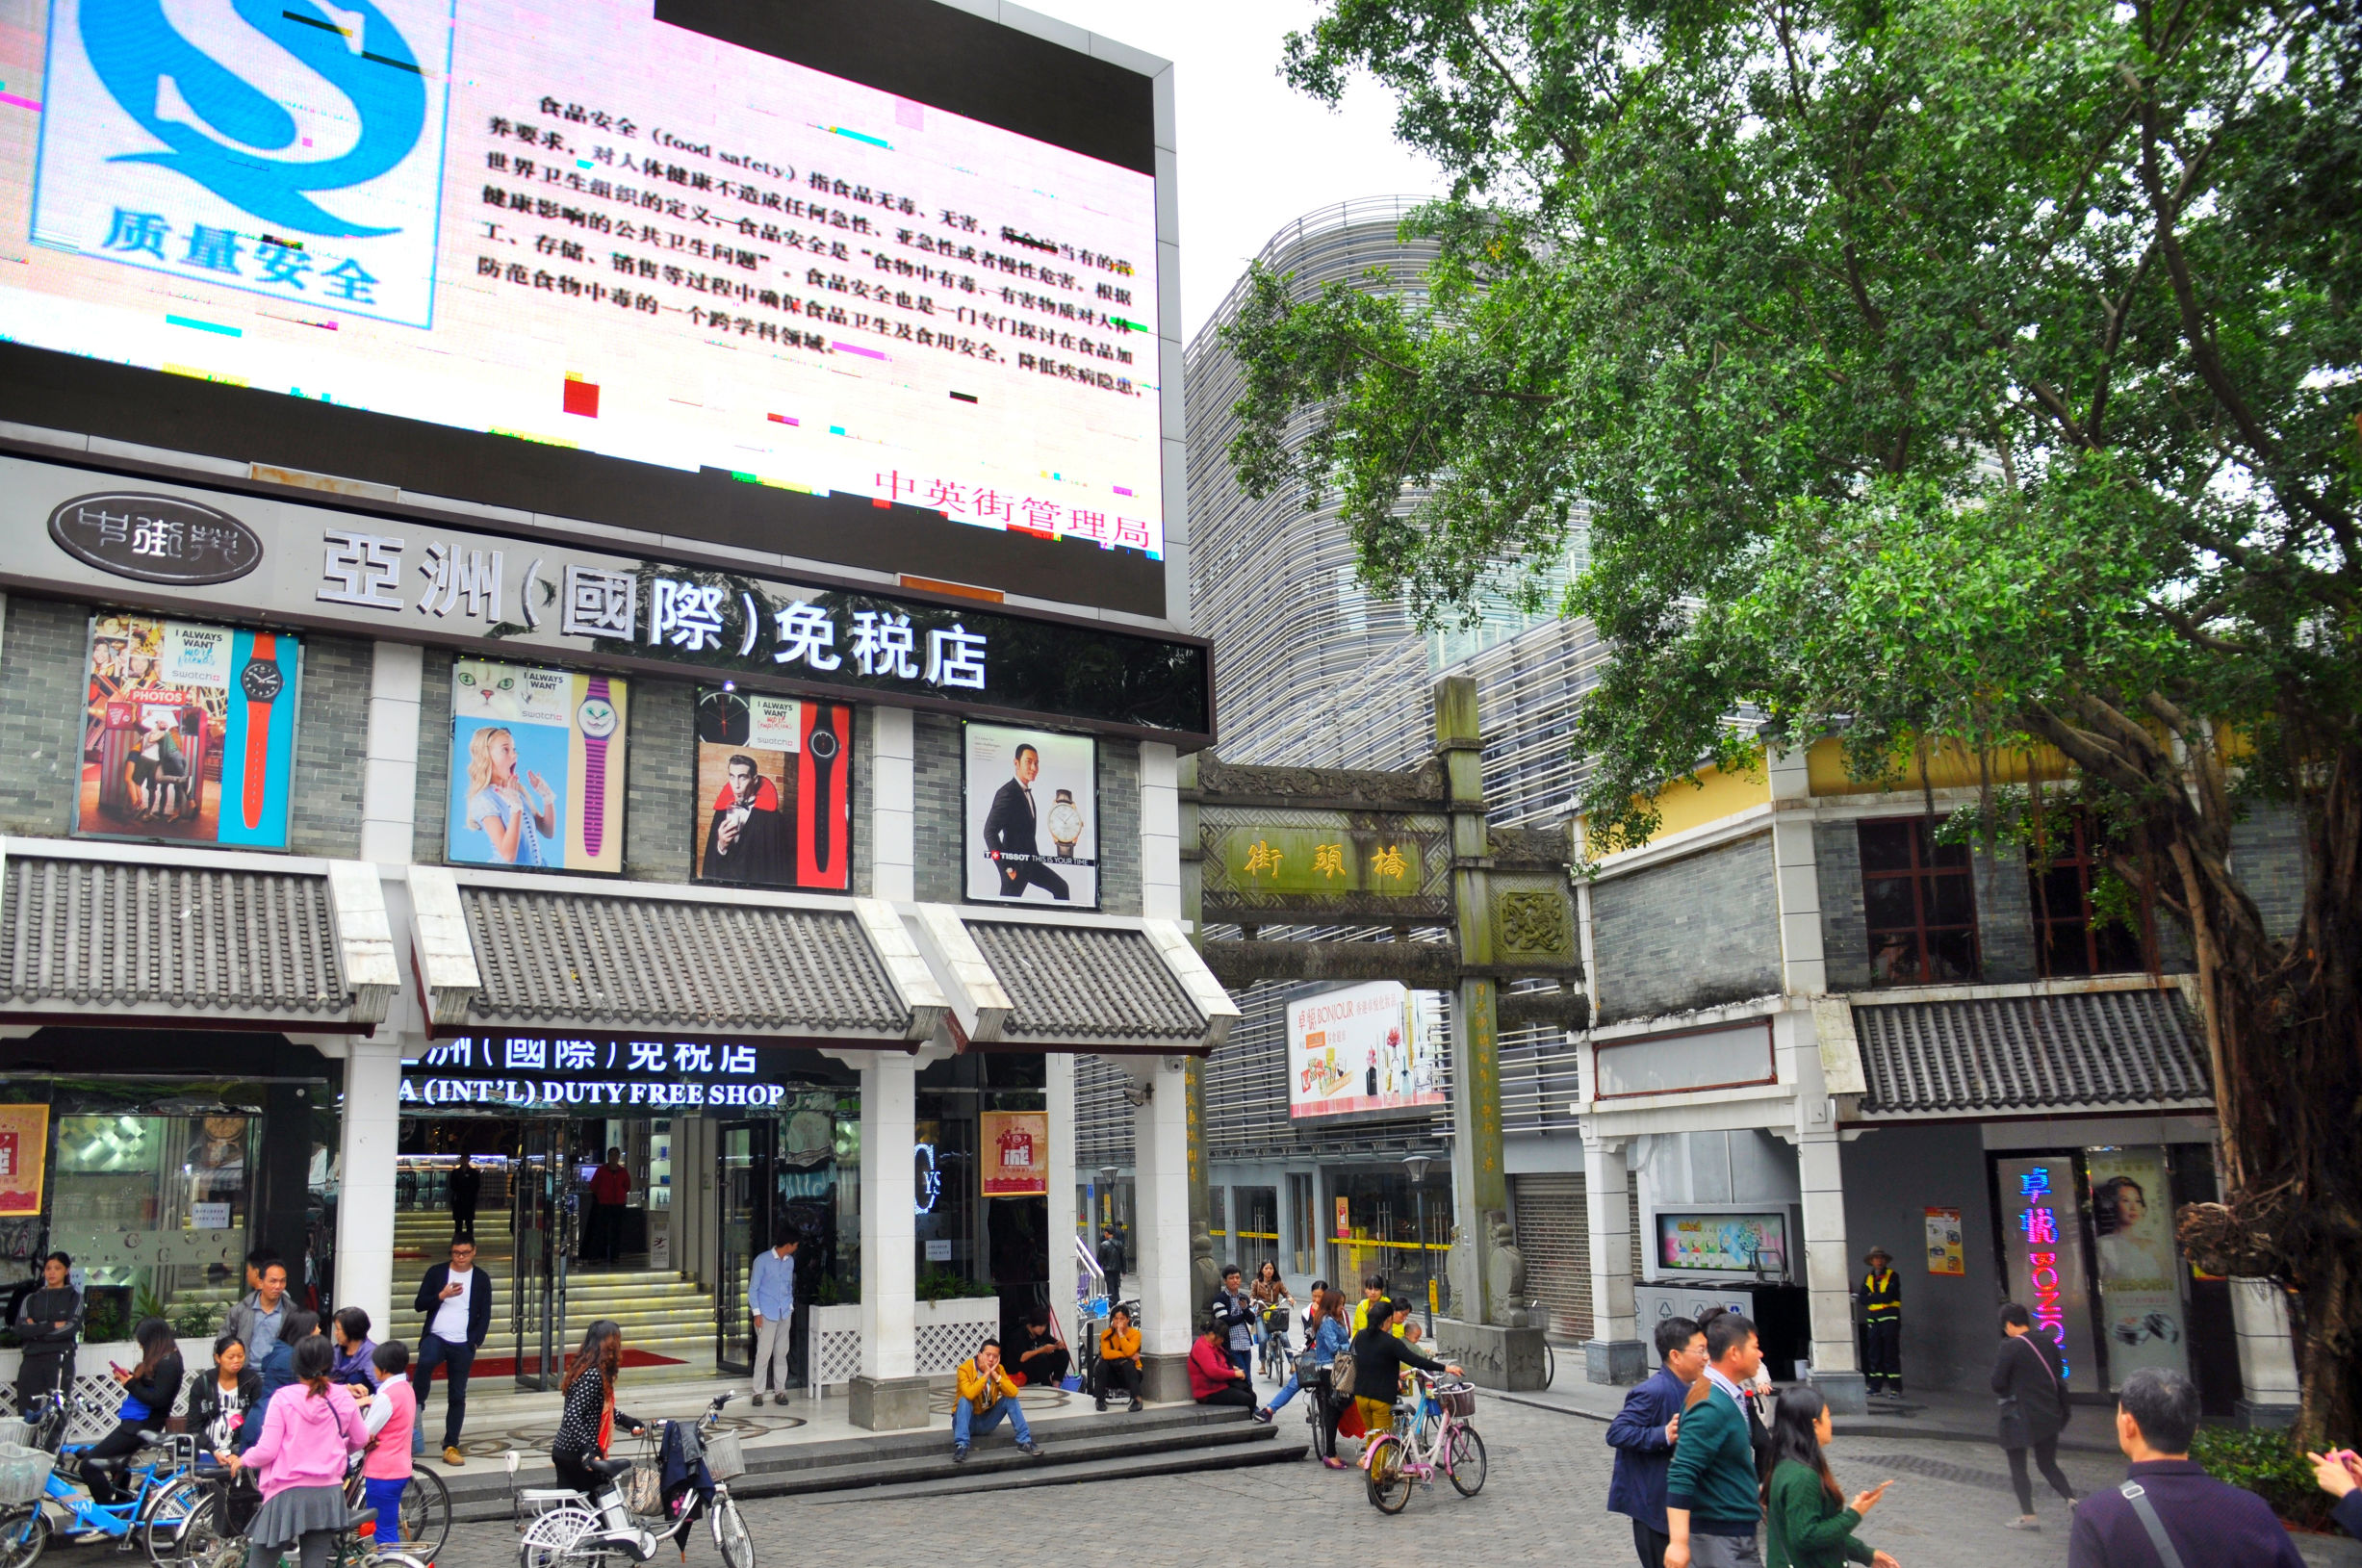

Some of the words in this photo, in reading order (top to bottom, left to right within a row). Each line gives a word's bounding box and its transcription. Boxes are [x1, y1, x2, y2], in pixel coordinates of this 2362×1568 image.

[101, 206, 380, 306] 质量安全
[875, 469, 1150, 549] 中英街管理局
[175, 629, 179, 637] I
[182, 630, 223, 642] ALWAYS
[183, 638, 215, 649] WANT
[171, 670, 213, 681] swatch
[524, 671, 527, 680] I
[528, 673, 564, 683] ALWAYS
[530, 681, 557, 690] WANT
[132, 690, 183, 703] PHOTOS
[762, 702, 793, 711] ALWAYS
[522, 710, 556, 720] swatch
[763, 708, 787, 717] WANT
[757, 736, 788, 746] swatch
[1000, 852, 1031, 861] TISSOT
[1031, 855, 1047, 863] THIS
[1317, 1001, 1354, 1025] BONJOUR
[542, 1081, 626, 1104] DUTY
[629, 1083, 705, 1105] FREE
[708, 1084, 785, 1106] SHOP
